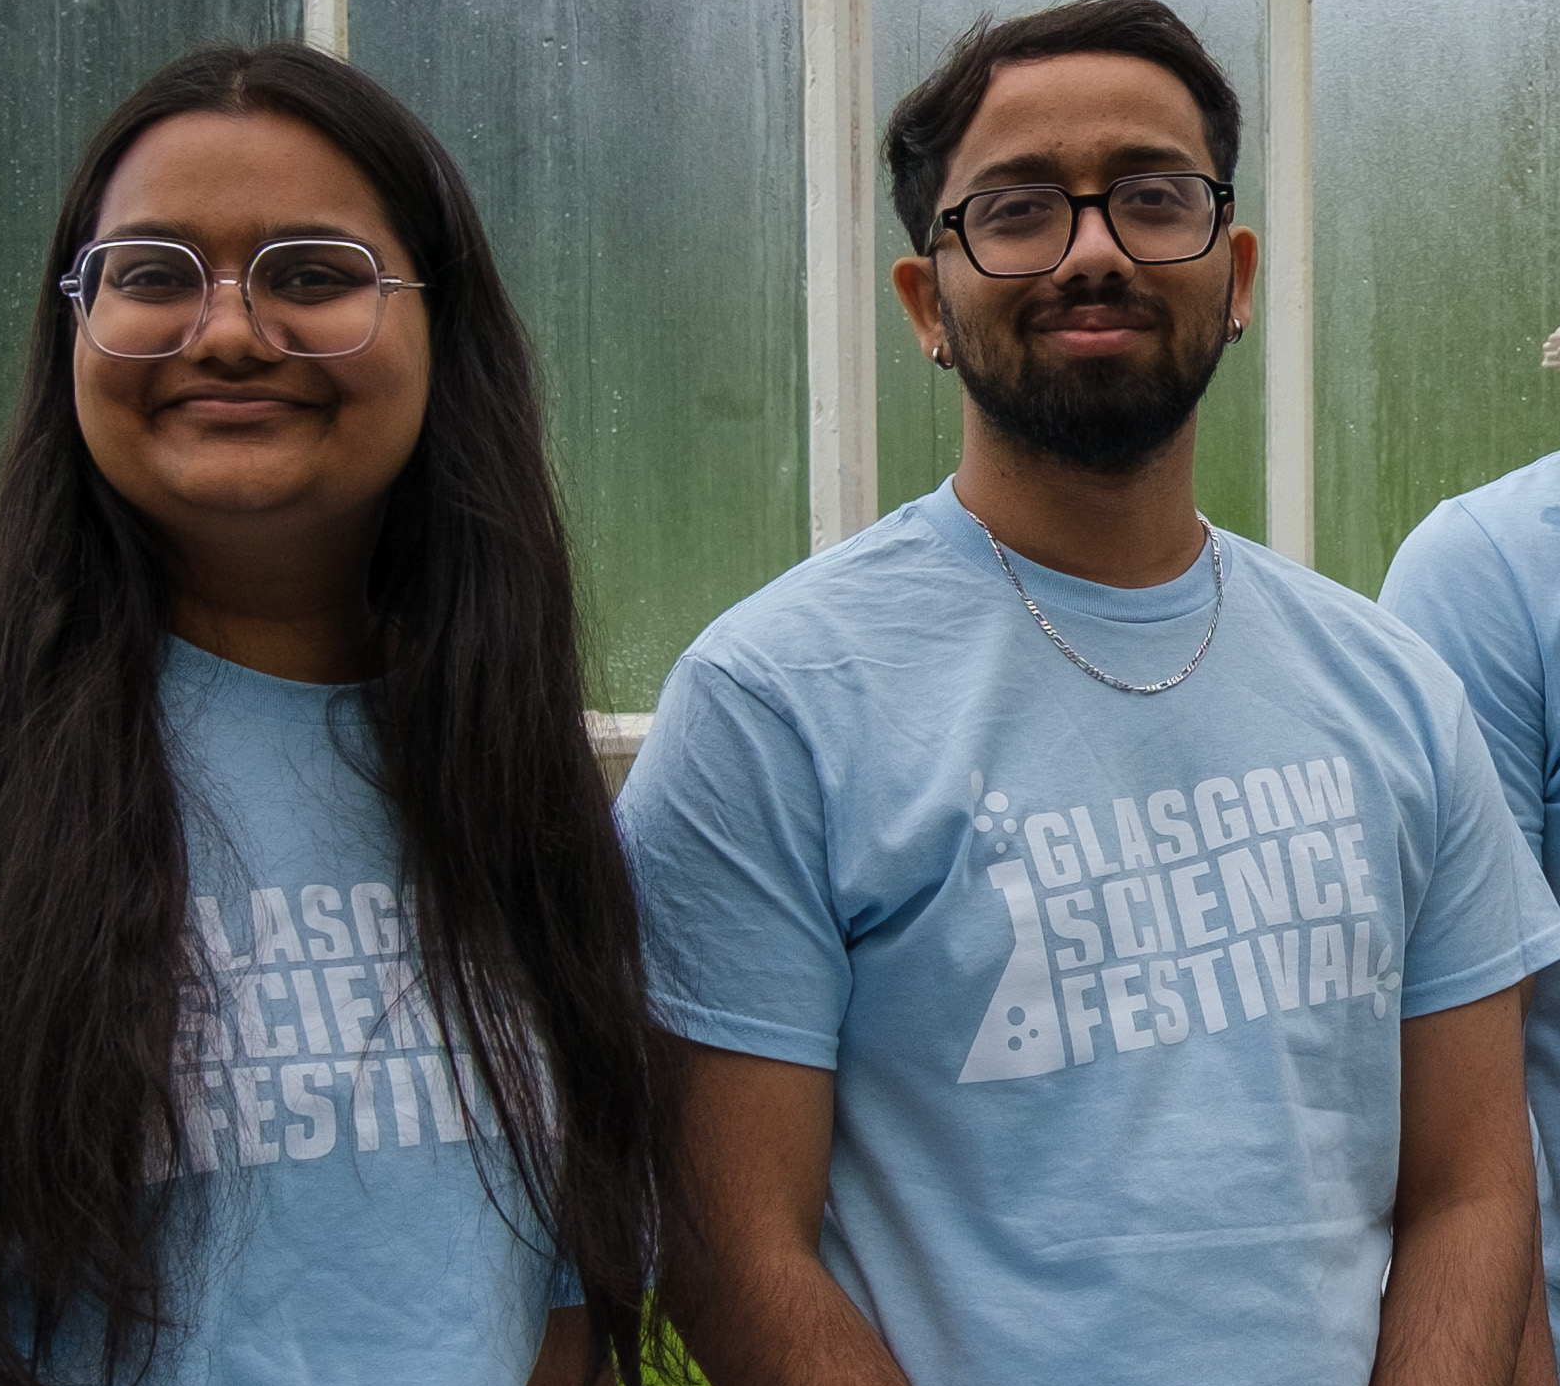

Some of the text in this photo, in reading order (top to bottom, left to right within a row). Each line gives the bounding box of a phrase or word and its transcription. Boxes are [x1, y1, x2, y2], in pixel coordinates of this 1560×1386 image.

[1023, 755, 1357, 890] GLASGOW
[1045, 823, 1378, 971] SCIENCE
[1061, 921, 1380, 1066] FESTIVAL
